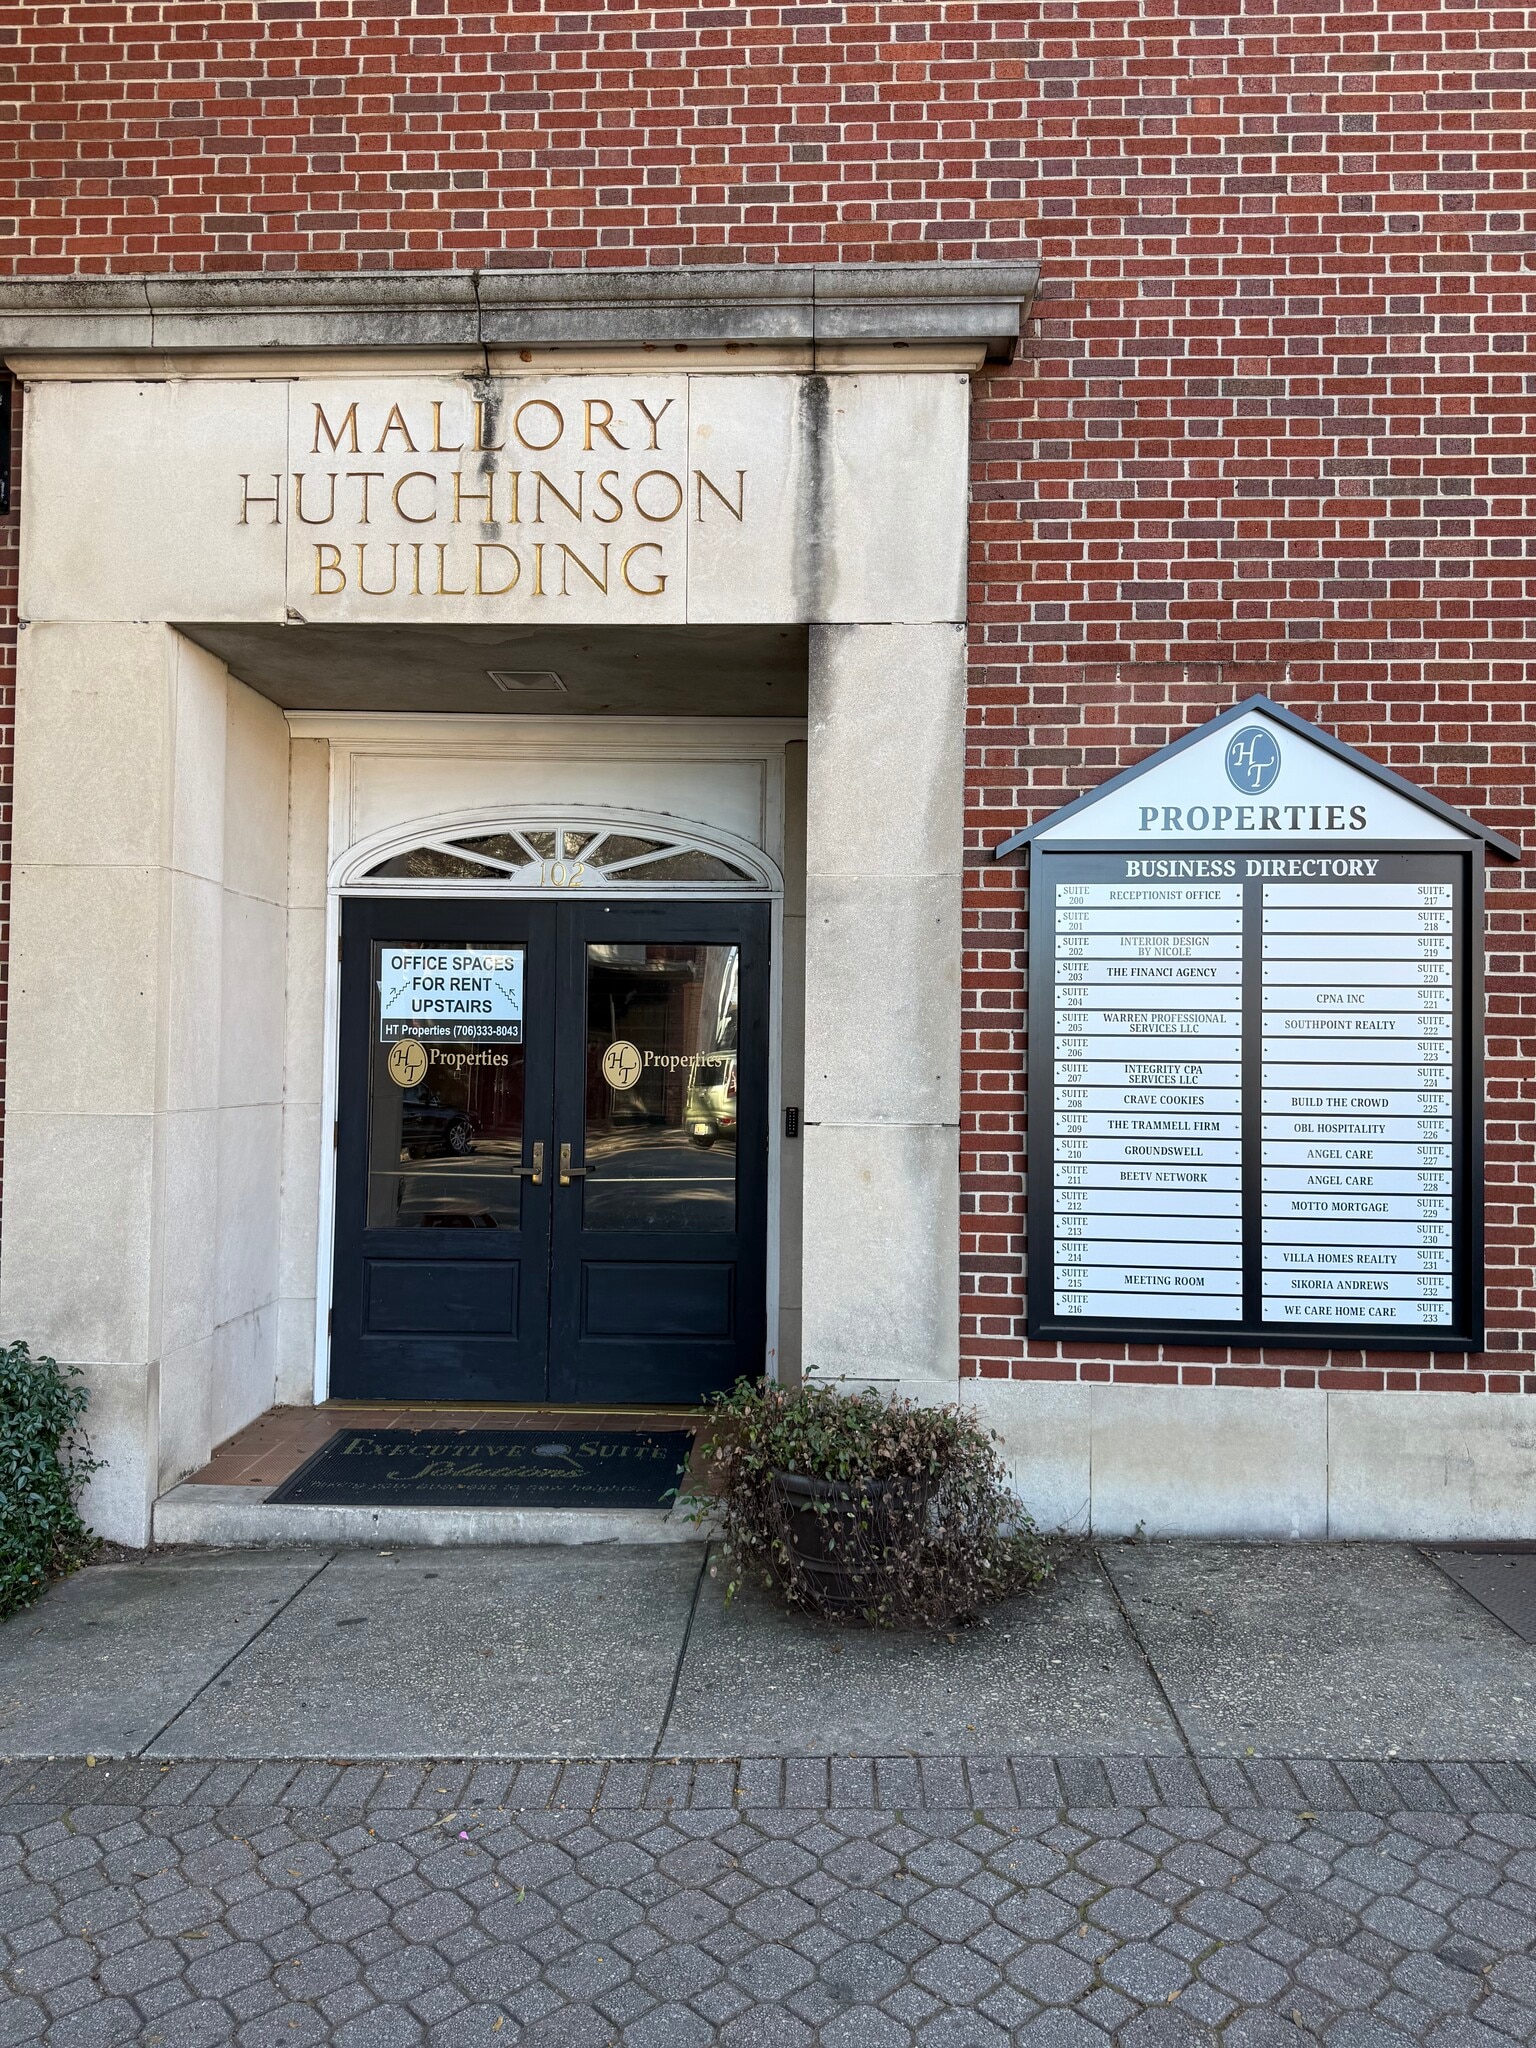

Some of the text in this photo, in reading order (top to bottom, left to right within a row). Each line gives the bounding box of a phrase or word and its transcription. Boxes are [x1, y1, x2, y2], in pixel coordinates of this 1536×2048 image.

[309, 399, 676, 453] MALLORY
[236, 470, 746, 524] HUTCHINSON
[311, 542, 668, 596] BUILDING
[1138, 805, 1367, 831] PROPERTIES
[1125, 858, 1379, 878] BUSINESS DIRECTORY
[540, 861, 585, 887] 102
[1110, 891, 1221, 899] RECEPTIONIST OFFICE
[1424, 897, 1437, 905] 217
[1063, 912, 1089, 920] SUITE
[1424, 923, 1438, 931] 218
[1120, 937, 1209, 946] INTERIOR DESIGN
[1138, 948, 1191, 956] BY NICOLE
[1424, 949, 1438, 957] 219
[391, 956, 514, 971] OFFICE SPACES
[1063, 963, 1089, 971] SUITE
[1107, 968, 1216, 976] THE FINANCI AGENCY
[1418, 964, 1444, 972] SUITE
[1068, 973, 1082, 981] 203
[1424, 975, 1438, 983] 220
[412, 977, 492, 991] FOR RENT
[1418, 990, 1444, 998] SUITE
[1317, 994, 1364, 1003] CPNA INC
[411, 999, 492, 1013] UPSTAIRS
[1103, 1014, 1226, 1023] WARREN PROFESSIONAL
[1418, 1017, 1444, 1025] SUITE
[1130, 1024, 1198, 1033] SERVICES LLC
[1285, 1020, 1395, 1029] SOUTHPOINT REALTY
[385, 1025, 518, 1038] HT Properties (706)333-8043
[1424, 1027, 1438, 1035] 222
[429, 1049, 509, 1070] Properties
[1424, 1053, 1438, 1061] 223
[643, 1051, 722, 1072] Properties
[1062, 1064, 1088, 1073] SUITE
[1125, 1065, 1202, 1074] INTEGRITY CPA
[1418, 1068, 1444, 1076] SUITE
[1068, 1074, 1082, 1082] 207
[1129, 1075, 1198, 1084] SERVICES LLC
[1424, 1079, 1437, 1087] 224
[1124, 1095, 1204, 1104] CRAVE COOKIES
[1417, 1094, 1444, 1102] SUITE
[1292, 1098, 1388, 1107] BUILD THE CROWD
[1423, 1105, 1437, 1113] 225
[1062, 1115, 1088, 1123] SUITE
[1068, 1125, 1082, 1133] 209
[1108, 1120, 1219, 1130] THE TRAMMELL FIRM
[1294, 1124, 1385, 1133] OBL HOSPITALITY
[1417, 1121, 1444, 1129] SUITE
[1423, 1131, 1438, 1139] 226
[1062, 1140, 1088, 1148] SUITE
[1125, 1146, 1203, 1156] GROUNDSWELL
[1417, 1146, 1444, 1154] SUITE
[1307, 1150, 1373, 1159] ANGEL CARE
[1423, 1157, 1437, 1165] 227
[1062, 1166, 1088, 1174] SUITE
[1068, 1176, 1080, 1184] 211
[1156, 1173, 1207, 1182] NETWORK
[1308, 1176, 1373, 1185] ANGEL CARE
[1418, 1173, 1444, 1181] SUITE
[1423, 1183, 1438, 1191] 228
[1062, 1192, 1088, 1200] SUITE
[1068, 1202, 1081, 1210] 212
[1292, 1202, 1388, 1211] MOTTO MORTGAGE
[1417, 1199, 1444, 1207] SUITE
[1062, 1217, 1088, 1225] SUITE
[1417, 1225, 1444, 1233] SUITE
[1062, 1243, 1088, 1251] SUITE
[1284, 1253, 1397, 1263] VILLA HOMES REALTY
[1417, 1251, 1444, 1259] SUITE
[1062, 1269, 1088, 1277] SUITE
[1068, 1279, 1082, 1287] 215
[1125, 1276, 1204, 1286] MEETING ROOM
[1291, 1280, 1388, 1290] SIKORIA ANDREWS
[1417, 1277, 1444, 1285] SUITE
[1423, 1288, 1437, 1296] 232
[1062, 1295, 1088, 1303] SUITE
[1068, 1305, 1082, 1313] 216
[1285, 1306, 1396, 1316] WE CARE HOME CARE
[1417, 1304, 1444, 1312] SUITE
[1423, 1314, 1438, 1322] 233
